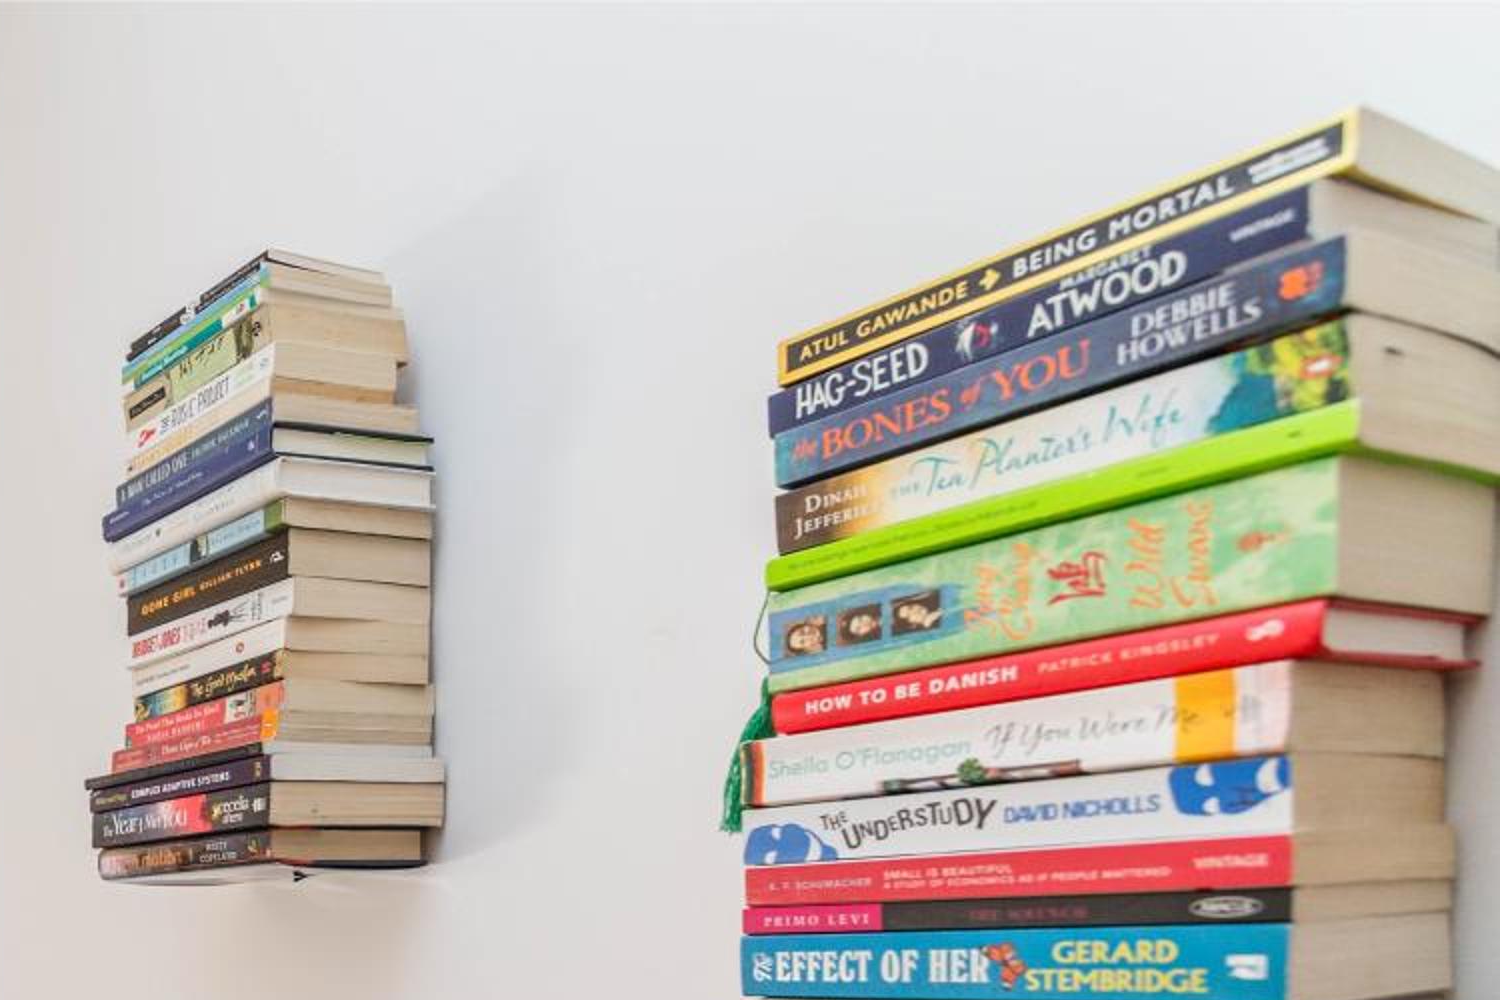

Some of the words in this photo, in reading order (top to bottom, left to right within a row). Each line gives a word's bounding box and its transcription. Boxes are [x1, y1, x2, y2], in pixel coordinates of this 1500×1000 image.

[1012, 227, 1097, 278] BEING
[1108, 175, 1235, 241] MORTAL
[1027, 250, 1188, 338] ATWOOD
[1131, 281, 1237, 338] DEBBIE
[799, 329, 850, 361] ATUL
[855, 279, 969, 338] GAWANDE
[1117, 300, 1263, 366] HOWELLS
[795, 341, 930, 419] HAG-SEED
[821, 387, 952, 462] BONES
[991, 338, 1092, 402] YOU
[1036, 651, 1114, 675] PATRICK
[1120, 633, 1219, 661] KINGSLEY
[804, 694, 852, 715] HOW
[859, 688, 887, 706] TO
[894, 682, 921, 700] BE
[928, 665, 1019, 694] DANISH
[819, 810, 848, 831] THE
[842, 797, 998, 849] UNDERSTUDY
[1003, 801, 1058, 824] DAVID
[1062, 792, 1162, 820] NICHOLLS
[763, 914, 820, 928] PRIMO
[827, 912, 869, 926] LEVI
[775, 949, 874, 983] EFFECT
[879, 949, 920, 983] OF
[928, 948, 991, 983] HER
[1051, 939, 1180, 964] GERARD
[1025, 967, 1209, 994] STEMBRIDGE
